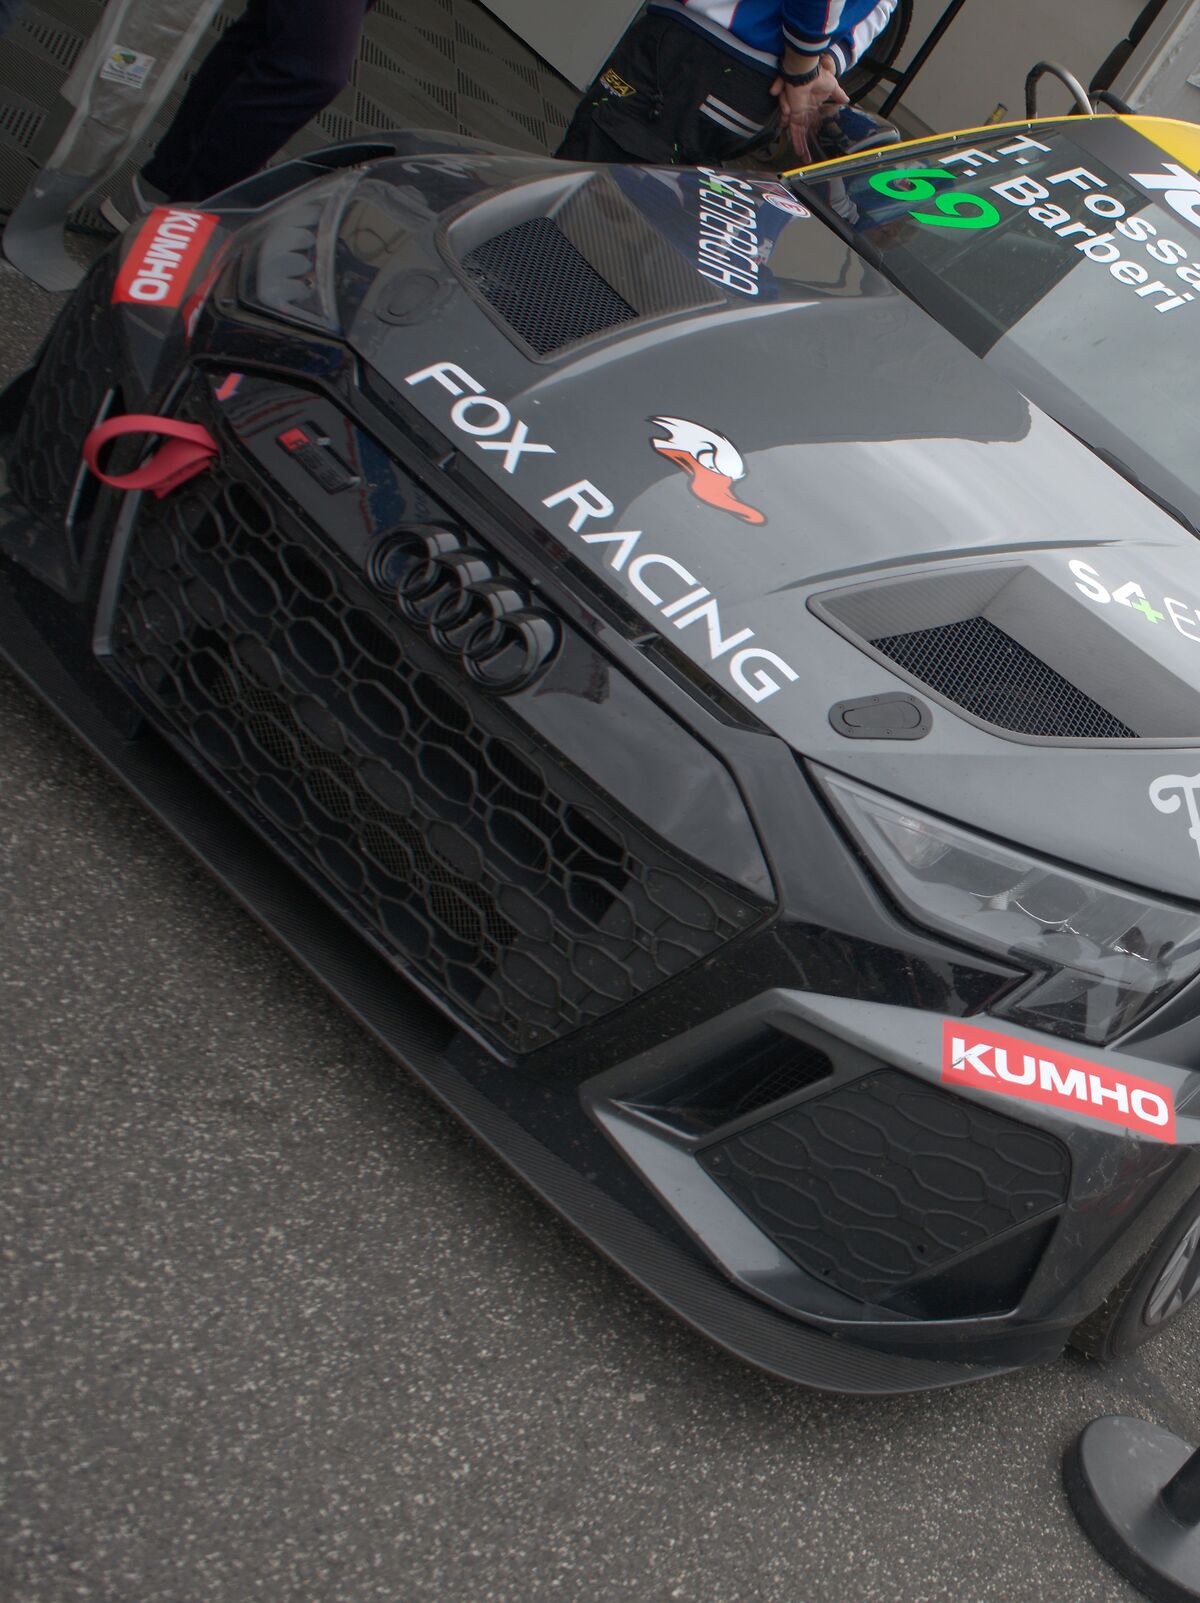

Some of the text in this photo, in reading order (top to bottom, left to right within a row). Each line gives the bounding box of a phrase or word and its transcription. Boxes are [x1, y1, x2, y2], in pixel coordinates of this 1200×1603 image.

[998, 135, 1051, 164] T.
[868, 169, 1000, 229] 69
[939, 148, 1195, 313] F. Barberi
[129, 210, 203, 301] KUMHO
[404, 362, 800, 703] FOX RACING
[952, 1037, 1169, 1126] KUMHO
